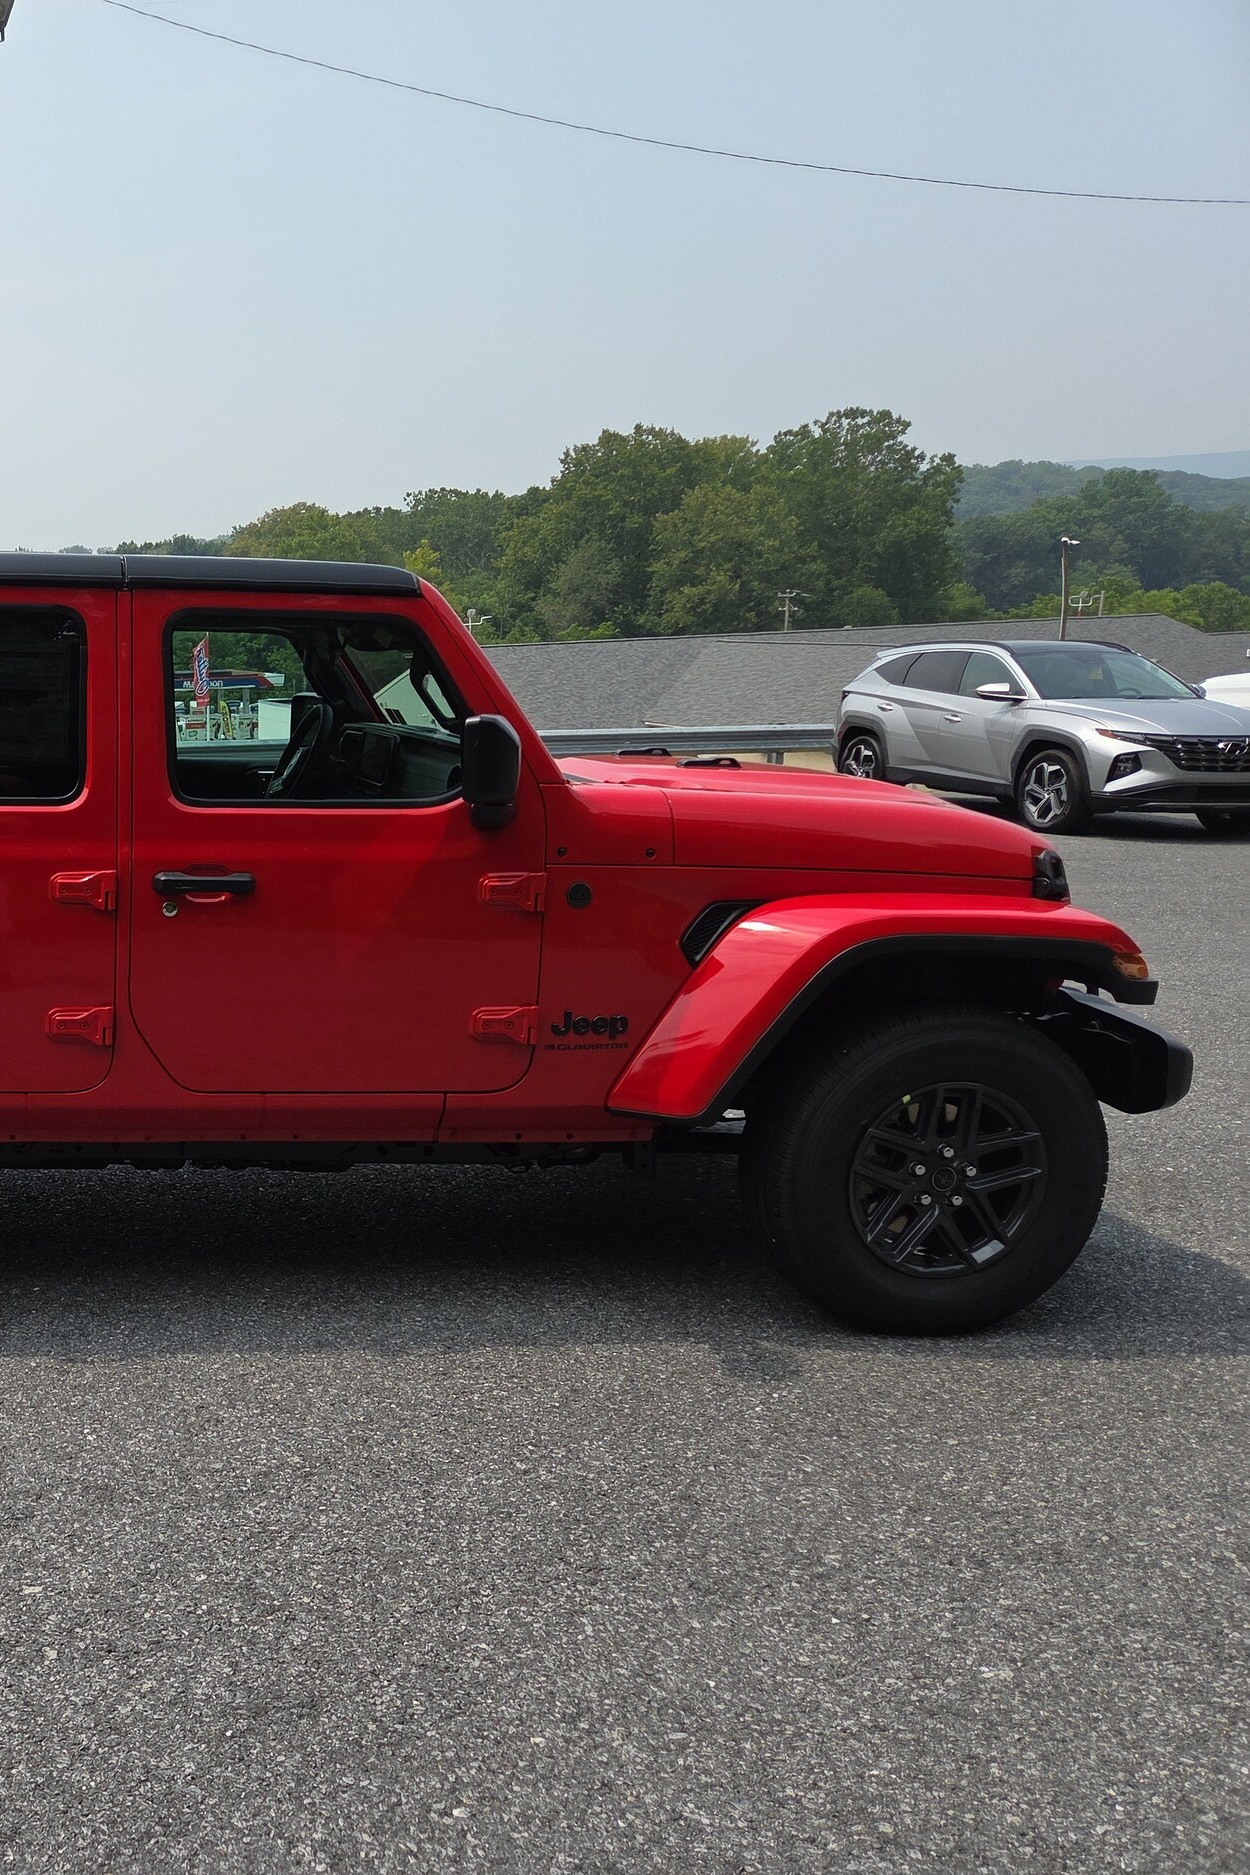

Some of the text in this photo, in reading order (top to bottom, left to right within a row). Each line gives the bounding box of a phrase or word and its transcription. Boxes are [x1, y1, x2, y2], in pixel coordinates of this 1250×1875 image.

[183, 680, 223, 688] Maon
[551, 1010, 629, 1040] Jeep
[557, 1042, 628, 1051] GLADIATOR
